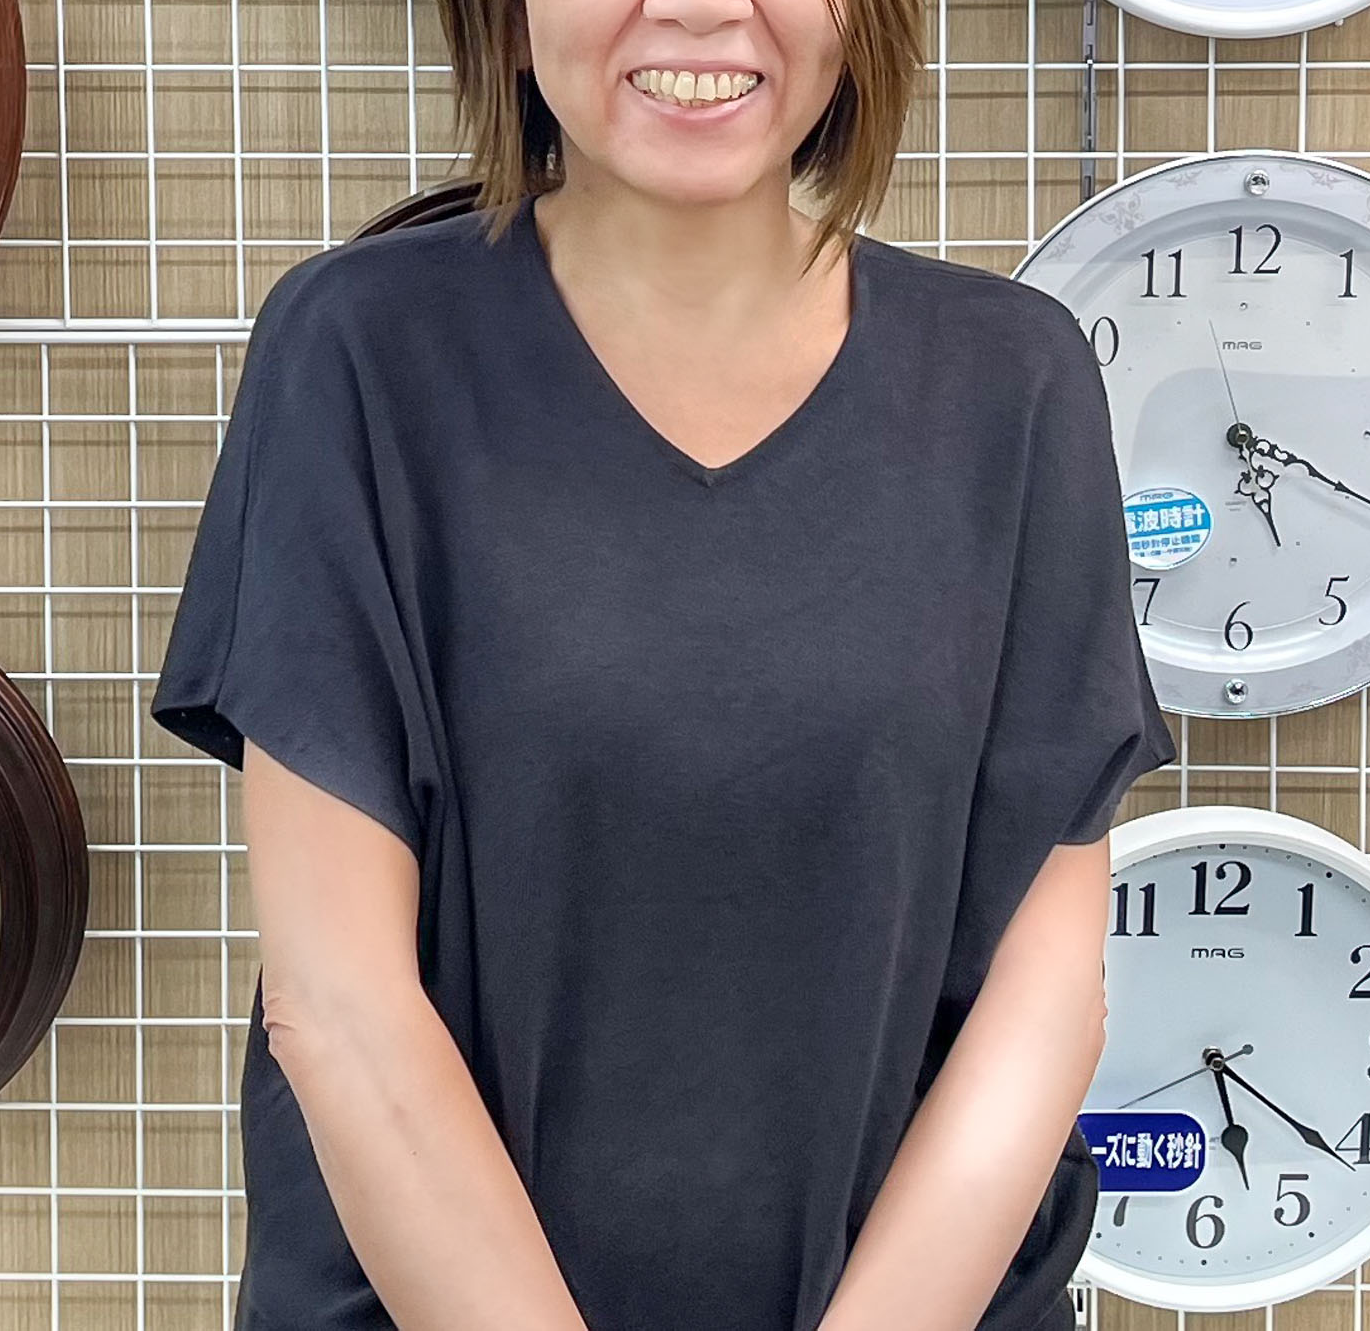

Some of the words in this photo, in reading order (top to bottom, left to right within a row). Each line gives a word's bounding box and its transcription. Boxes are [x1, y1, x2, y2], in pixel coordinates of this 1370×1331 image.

[1141, 249, 1186, 297] 11
[1229, 224, 1281, 274] 12
[1223, 341, 1262, 350] MAG
[1189, 861, 1251, 915] 12
[1191, 948, 1245, 958] MAG
[1186, 1196, 1224, 1248] 6
[1275, 1174, 1310, 1226] 5
